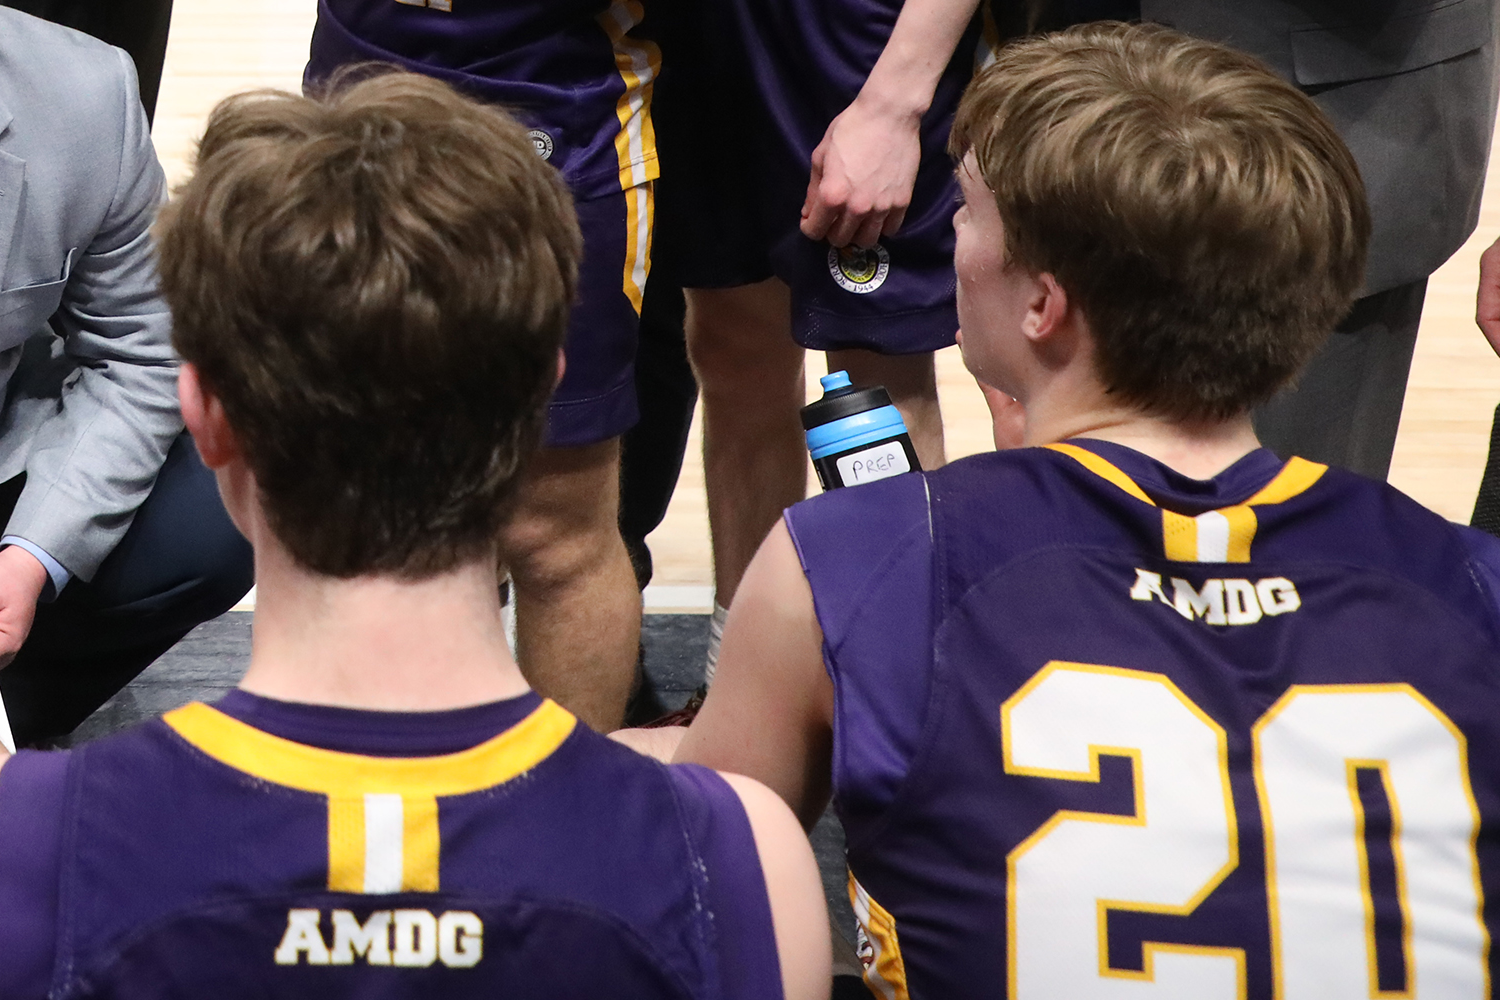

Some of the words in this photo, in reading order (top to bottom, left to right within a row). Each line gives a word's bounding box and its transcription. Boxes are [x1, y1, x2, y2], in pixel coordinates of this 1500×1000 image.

[852, 453, 896, 481] PREP
[1129, 567, 1302, 626] AMDG
[1000, 660, 1492, 1000] 20
[273, 907, 485, 969] AMDG
